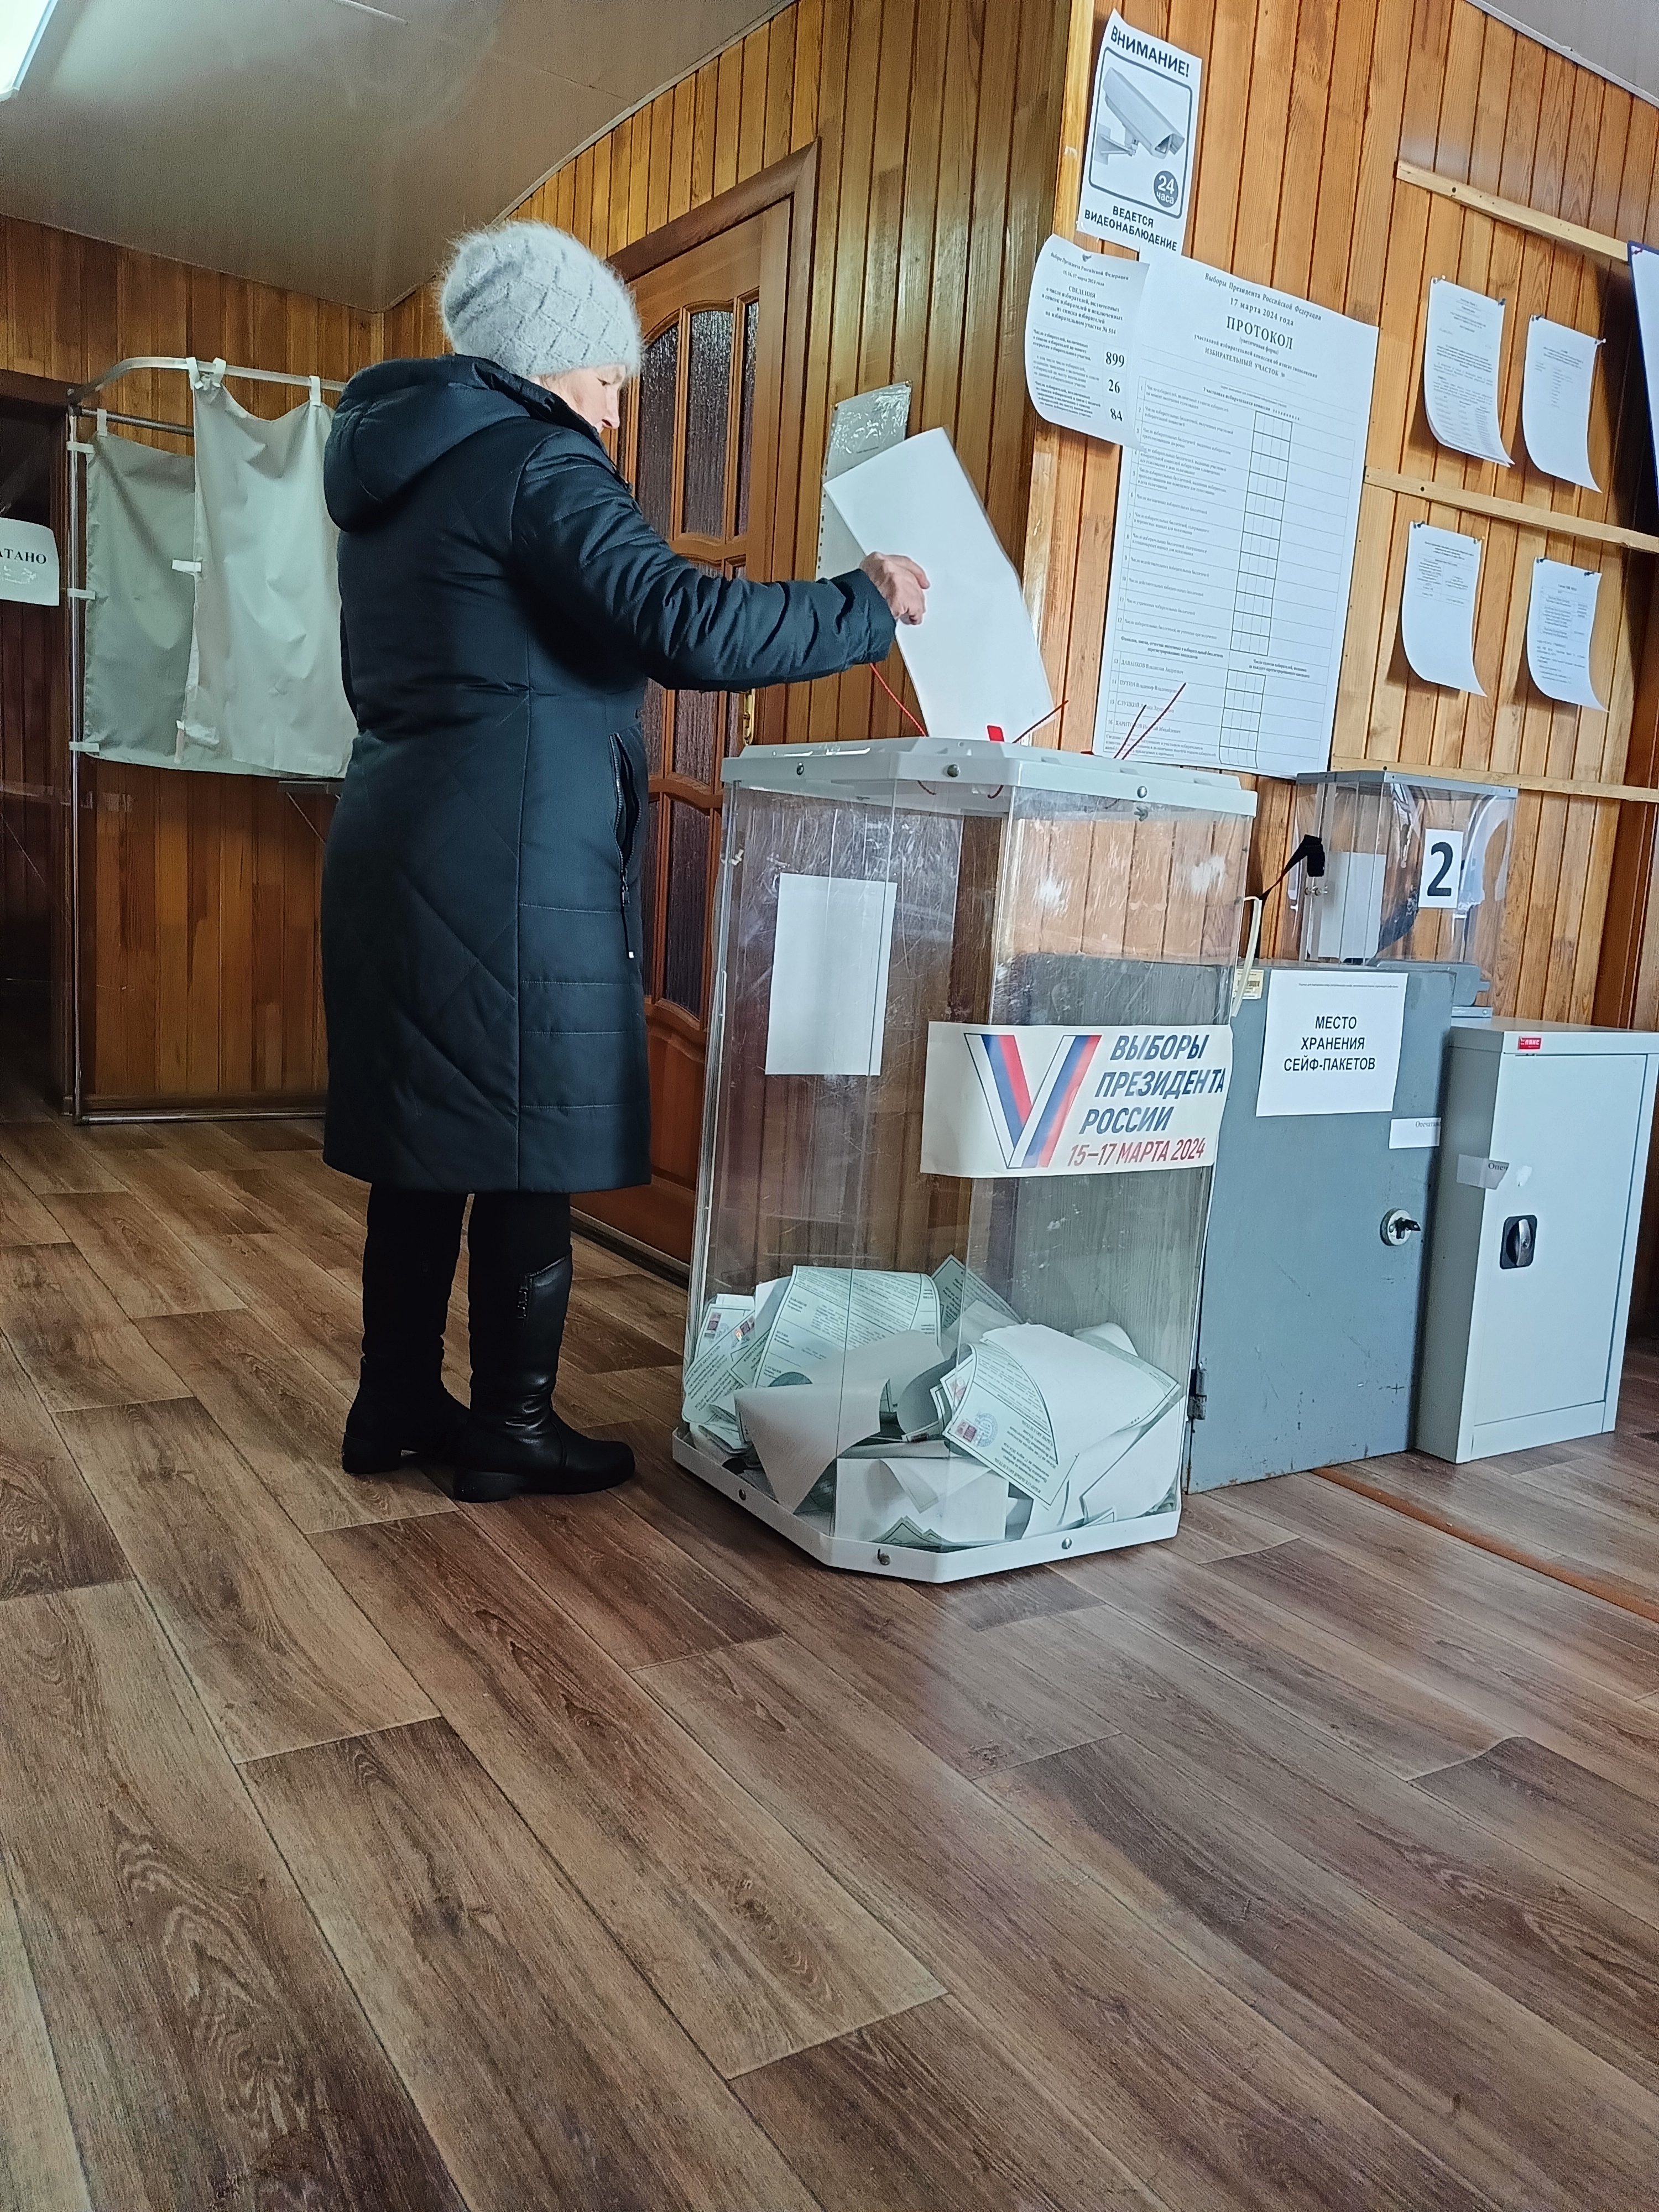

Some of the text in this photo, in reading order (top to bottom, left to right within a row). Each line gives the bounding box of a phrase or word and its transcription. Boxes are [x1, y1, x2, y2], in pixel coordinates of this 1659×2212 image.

[1111, 25, 1190, 77] ВНИМАНИЕ!
[1157, 191, 1174, 204] часа
[1158, 175, 1175, 194] 24
[1084, 210, 1177, 251] ВИДЕОНАБЛЮДЕНИЕ
[1113, 206, 1154, 228] ВЕДЕТСЯ
[1205, 273, 1321, 321] Выборы Президента Российской Федерации
[1230, 298, 1294, 326] 17 марта 2024 года
[1227, 316, 1293, 349] ПРОТОКОЛ
[1106, 351, 1125, 367] 899
[1205, 348, 1253, 367] ИЗБИРАТЕЛЬНЫЙ
[1255, 363, 1279, 376] УЧАСТОК
[1108, 379, 1120, 393] 26
[1110, 408, 1123, 421] 84
[1427, 842, 1453, 896] 2
[1315, 1016, 1357, 1029] МЕСТО
[1110, 1034, 1209, 1061] ВЫБОРЫ
[1301, 1037, 1365, 1050] ХРАНЕНИЯ
[1284, 1055, 1375, 1071] СЕЙФ-ПАКЕТОВ
[1094, 1068, 1225, 1099] ПРЕЗИДЕНТА
[1079, 1107, 1175, 1134] РОССИИ
[1119, 1140, 1169, 1164] МАРТА
[1171, 1137, 1206, 1161] 2024
